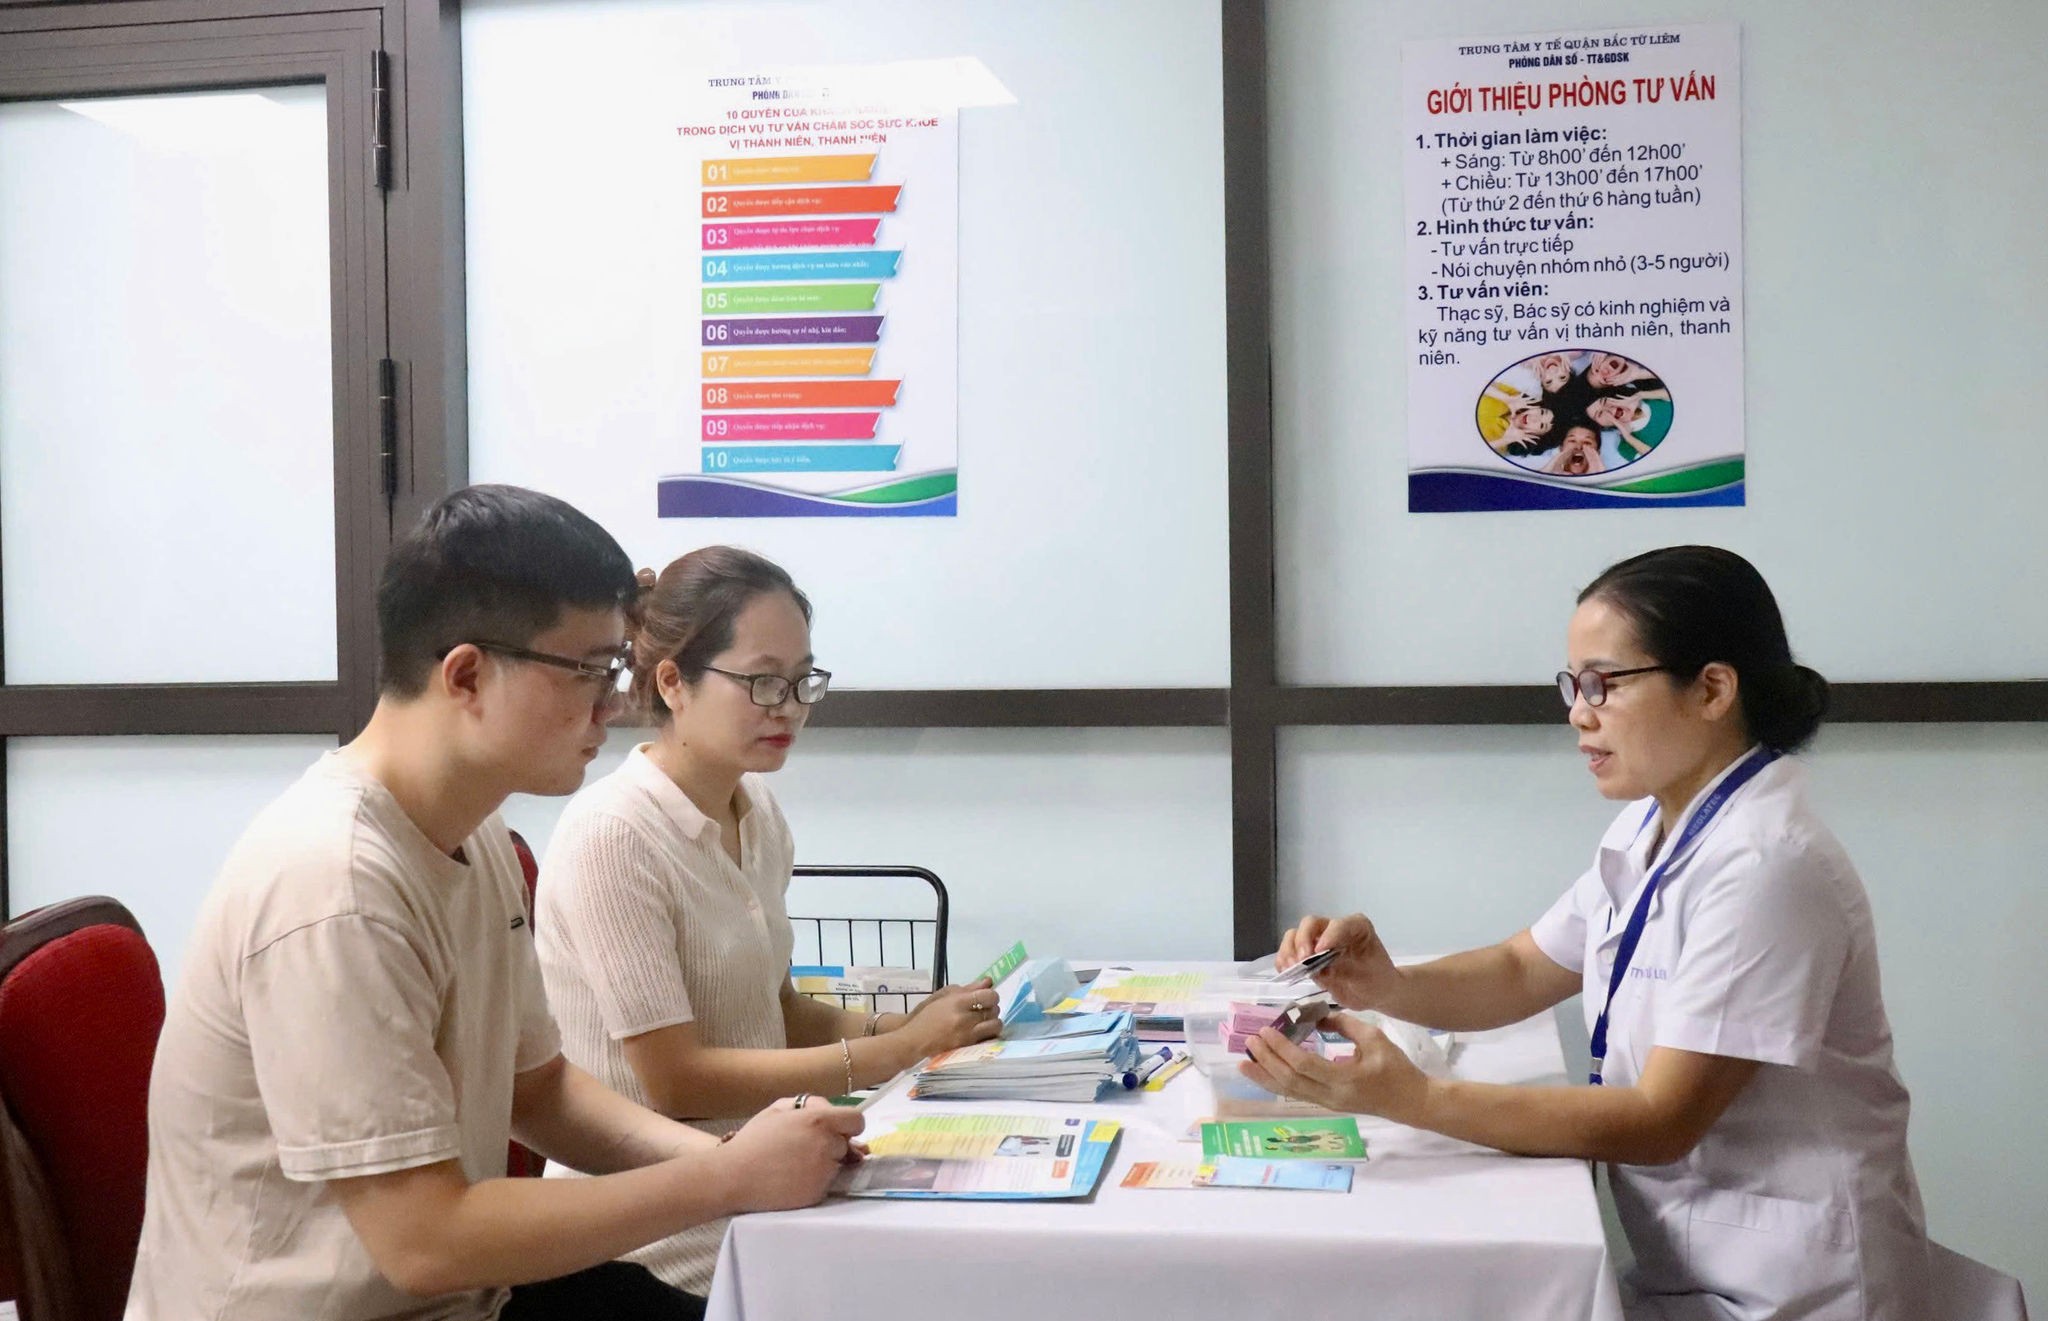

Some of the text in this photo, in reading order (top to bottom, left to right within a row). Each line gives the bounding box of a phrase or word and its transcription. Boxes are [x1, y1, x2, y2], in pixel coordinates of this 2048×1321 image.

[1459, 33, 1680, 55] TRUNG TÂM Y TẾ QUẬN BẮC TỪ LIÊM
[709, 78, 745, 87] TRUNG
[1428, 70, 1715, 116] GIỚI THIỆU PHÒNG TƯ VẤN
[727, 111, 738, 120] 10
[677, 127, 715, 136] TRONG
[719, 125, 745, 136] DỊCH
[749, 124, 764, 134] VỤ
[768, 123, 783, 132] TƯ
[730, 140, 740, 150] VỊ
[744, 137, 781, 148] THÀNH
[818, 136, 856, 146] THANH
[1416, 126, 1606, 150] 1. Thời gian làm việc:
[1441, 158, 1451, 167] +
[1456, 154, 1505, 172] Sáng:
[1509, 151, 1534, 166] Từ
[1589, 144, 1621, 162] đến
[708, 166, 728, 180] 01
[1442, 179, 1451, 189] +
[1456, 170, 1511, 190] Chiều:
[1516, 172, 1540, 187] Từ
[1607, 165, 1638, 183] đến
[707, 197, 728, 212] 02
[1442, 185, 1700, 216] (Từ thứ 2 đến thứ 6 hàng tuần)
[1417, 211, 1593, 236] 2. Hình thức tư vấn:
[707, 229, 728, 244] 03
[1441, 242, 1465, 256] Tư
[1469, 237, 1499, 255] vấn
[1504, 240, 1538, 256] trực
[1542, 233, 1573, 255] tiếp
[707, 261, 728, 277] 04
[1442, 263, 1474, 277] Nói
[1476, 260, 1536, 279] chuyện
[1541, 258, 1589, 274] nhóm
[1594, 256, 1626, 272] nhỏ
[1631, 255, 1665, 274] (3-5
[1670, 252, 1729, 273] người)
[1419, 280, 1548, 300] 3. Tư vấn viên:
[707, 294, 727, 308] 05
[1437, 297, 1730, 323] Thạc sỹ, Bác sỹ có kinh nghiệm và
[706, 325, 728, 340] 06
[1419, 319, 1730, 347] kỹ năng tư vấn vị thành niên, thanh
[708, 356, 728, 372] 07
[1420, 350, 1459, 365] niên.
[707, 388, 727, 404] 08
[707, 420, 727, 435] 09
[707, 452, 727, 467] 10
